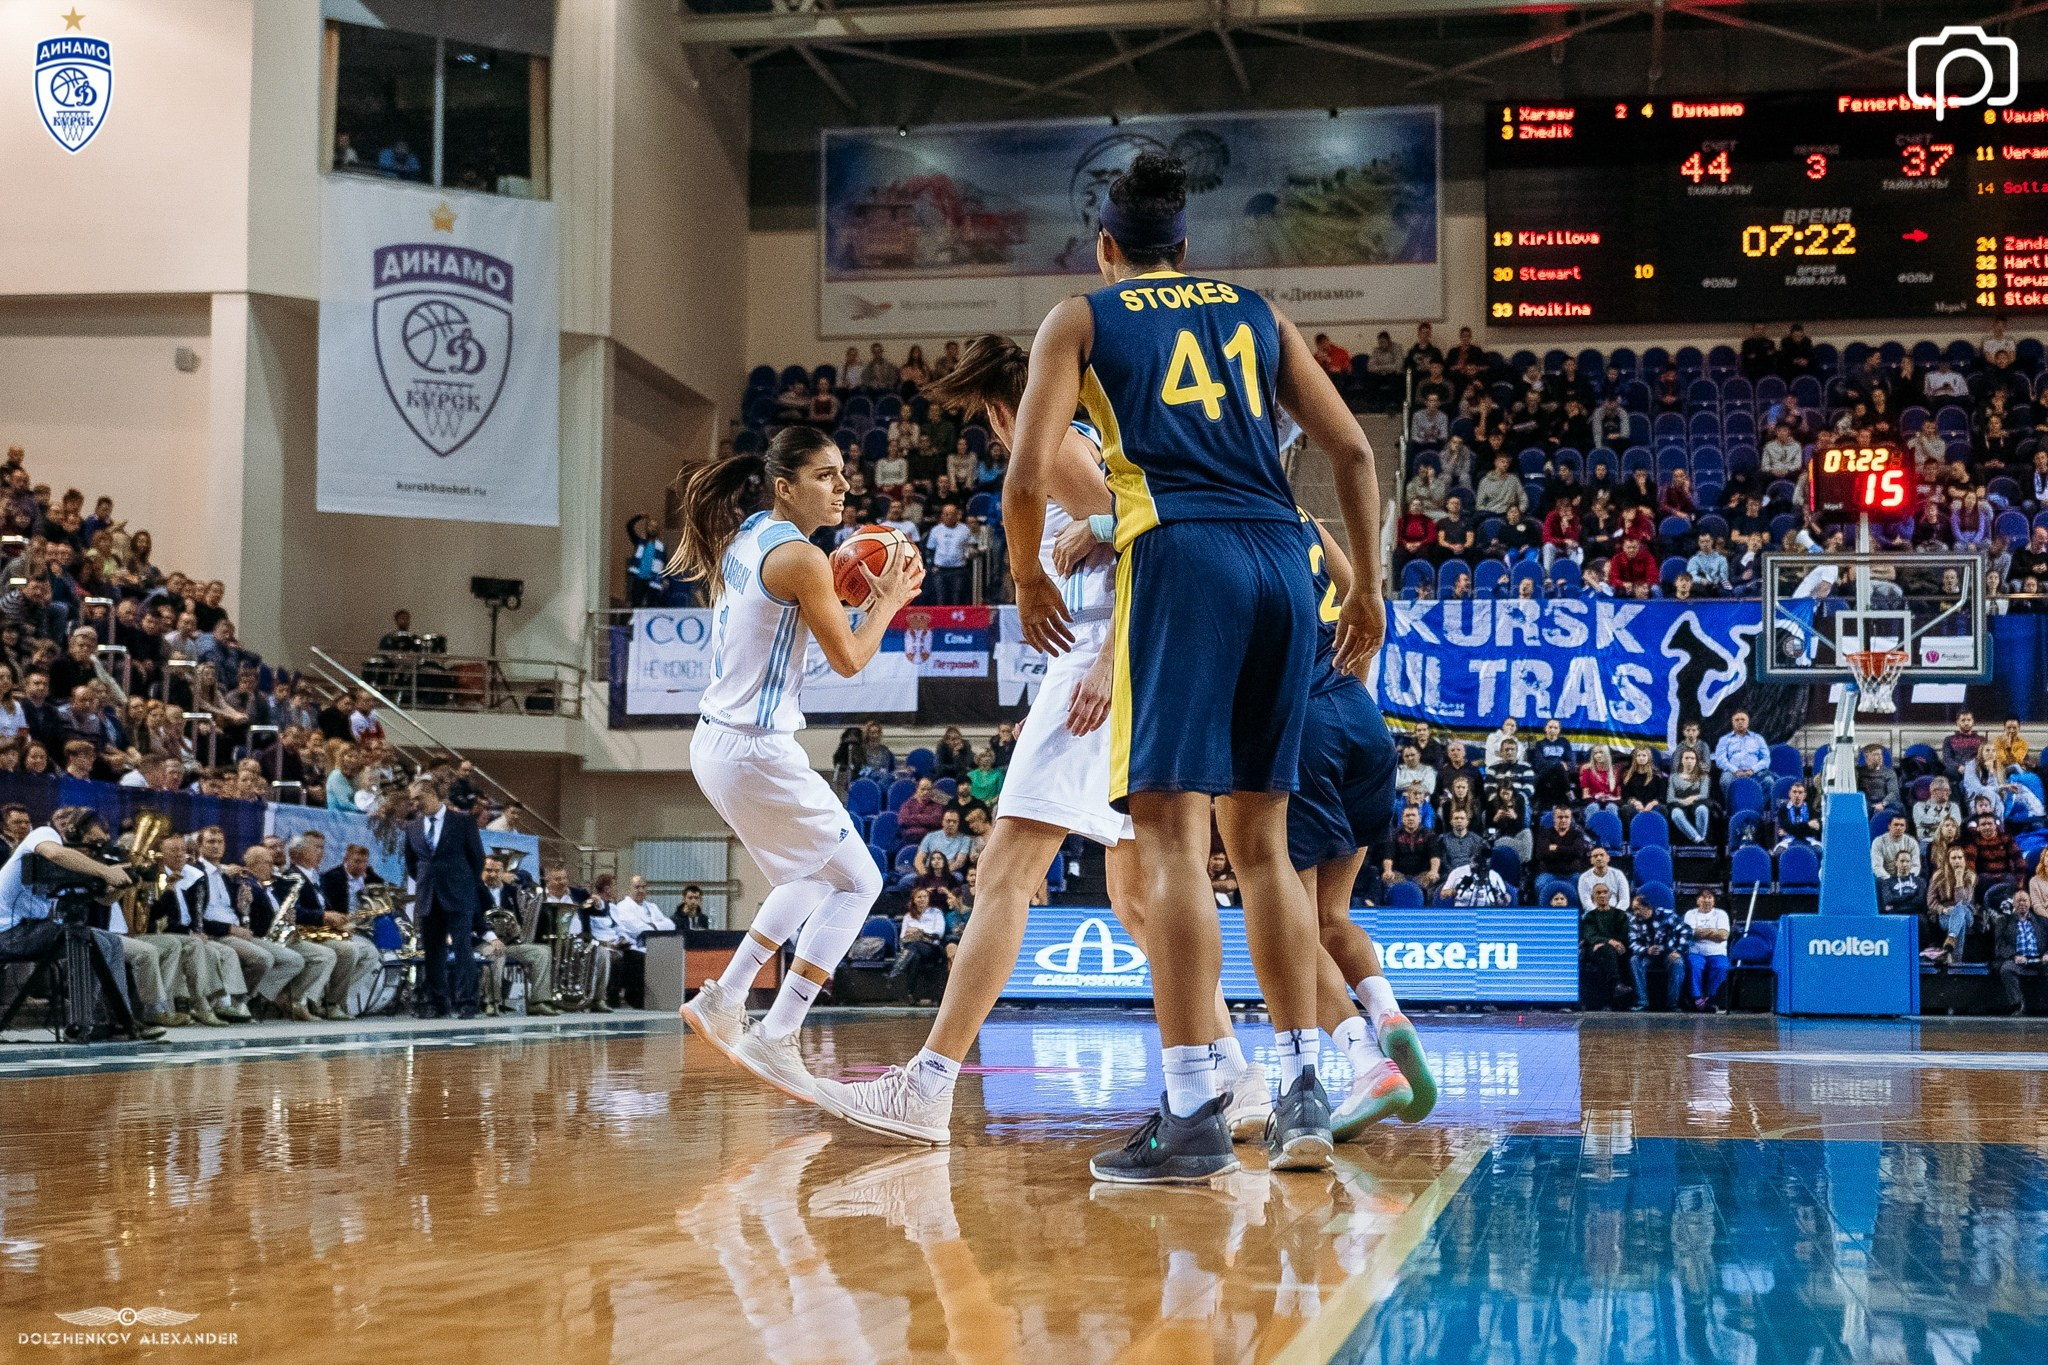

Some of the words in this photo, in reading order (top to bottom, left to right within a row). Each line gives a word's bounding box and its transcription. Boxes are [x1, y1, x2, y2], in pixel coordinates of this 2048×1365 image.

[1503, 106, 1512, 122] 1
[1614, 103, 1628, 119] 2
[1640, 103, 1654, 118] 4
[1671, 102, 1745, 119] Dynamo
[1518, 124, 1574, 140] Zhedik
[1903, 144, 1954, 177] 37
[1976, 146, 1994, 161] 11
[1681, 152, 1732, 183] 44
[1806, 153, 1827, 180] 3
[1977, 182, 1994, 195] 14
[1783, 207, 1852, 225] ВРЕМЯ
[1493, 231, 1513, 246] 13
[1518, 231, 1600, 246] Kirillova
[1743, 224, 1856, 257] 07:22
[1976, 236, 1997, 252] 24
[1976, 254, 1997, 271] 32
[382, 252, 506, 292] ДИНАМО
[1493, 267, 1514, 282] 30
[1519, 266, 1582, 282] Stewart
[1634, 264, 1654, 279] 10
[1976, 273, 1997, 289] 33
[1120, 282, 1239, 311] STOKES
[1976, 291, 1996, 307] 41
[1492, 302, 1513, 318] 33
[1518, 302, 1593, 317] Anoikina
[1162, 323, 1262, 420] 41
[1865, 470, 1904, 506] 15
[1391, 598, 1646, 653] KURSK
[1384, 643, 1653, 724] ULTRAS
[1808, 936, 1889, 956] molten
